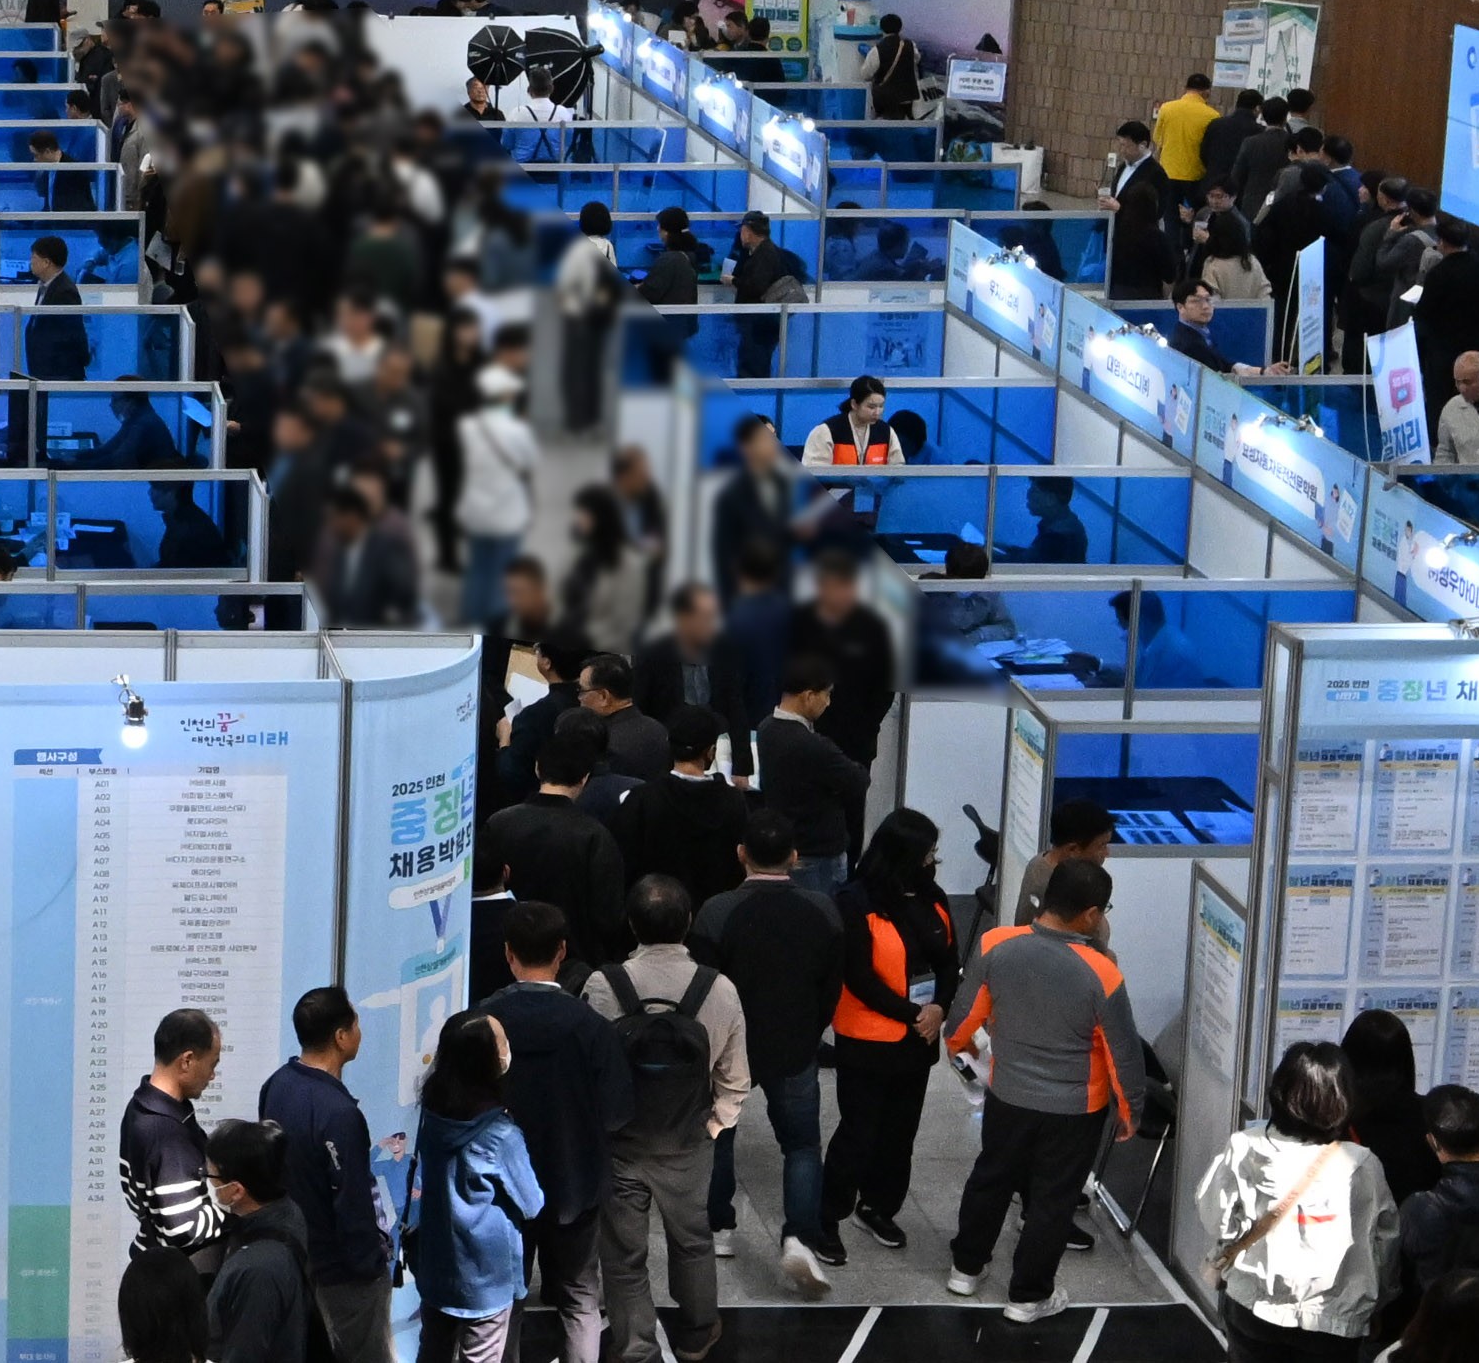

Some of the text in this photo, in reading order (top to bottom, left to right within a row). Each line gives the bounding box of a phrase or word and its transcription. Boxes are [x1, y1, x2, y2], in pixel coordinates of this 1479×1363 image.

[246, 732, 289, 746] 미래
[392, 772, 446, 797] 2025 인천
